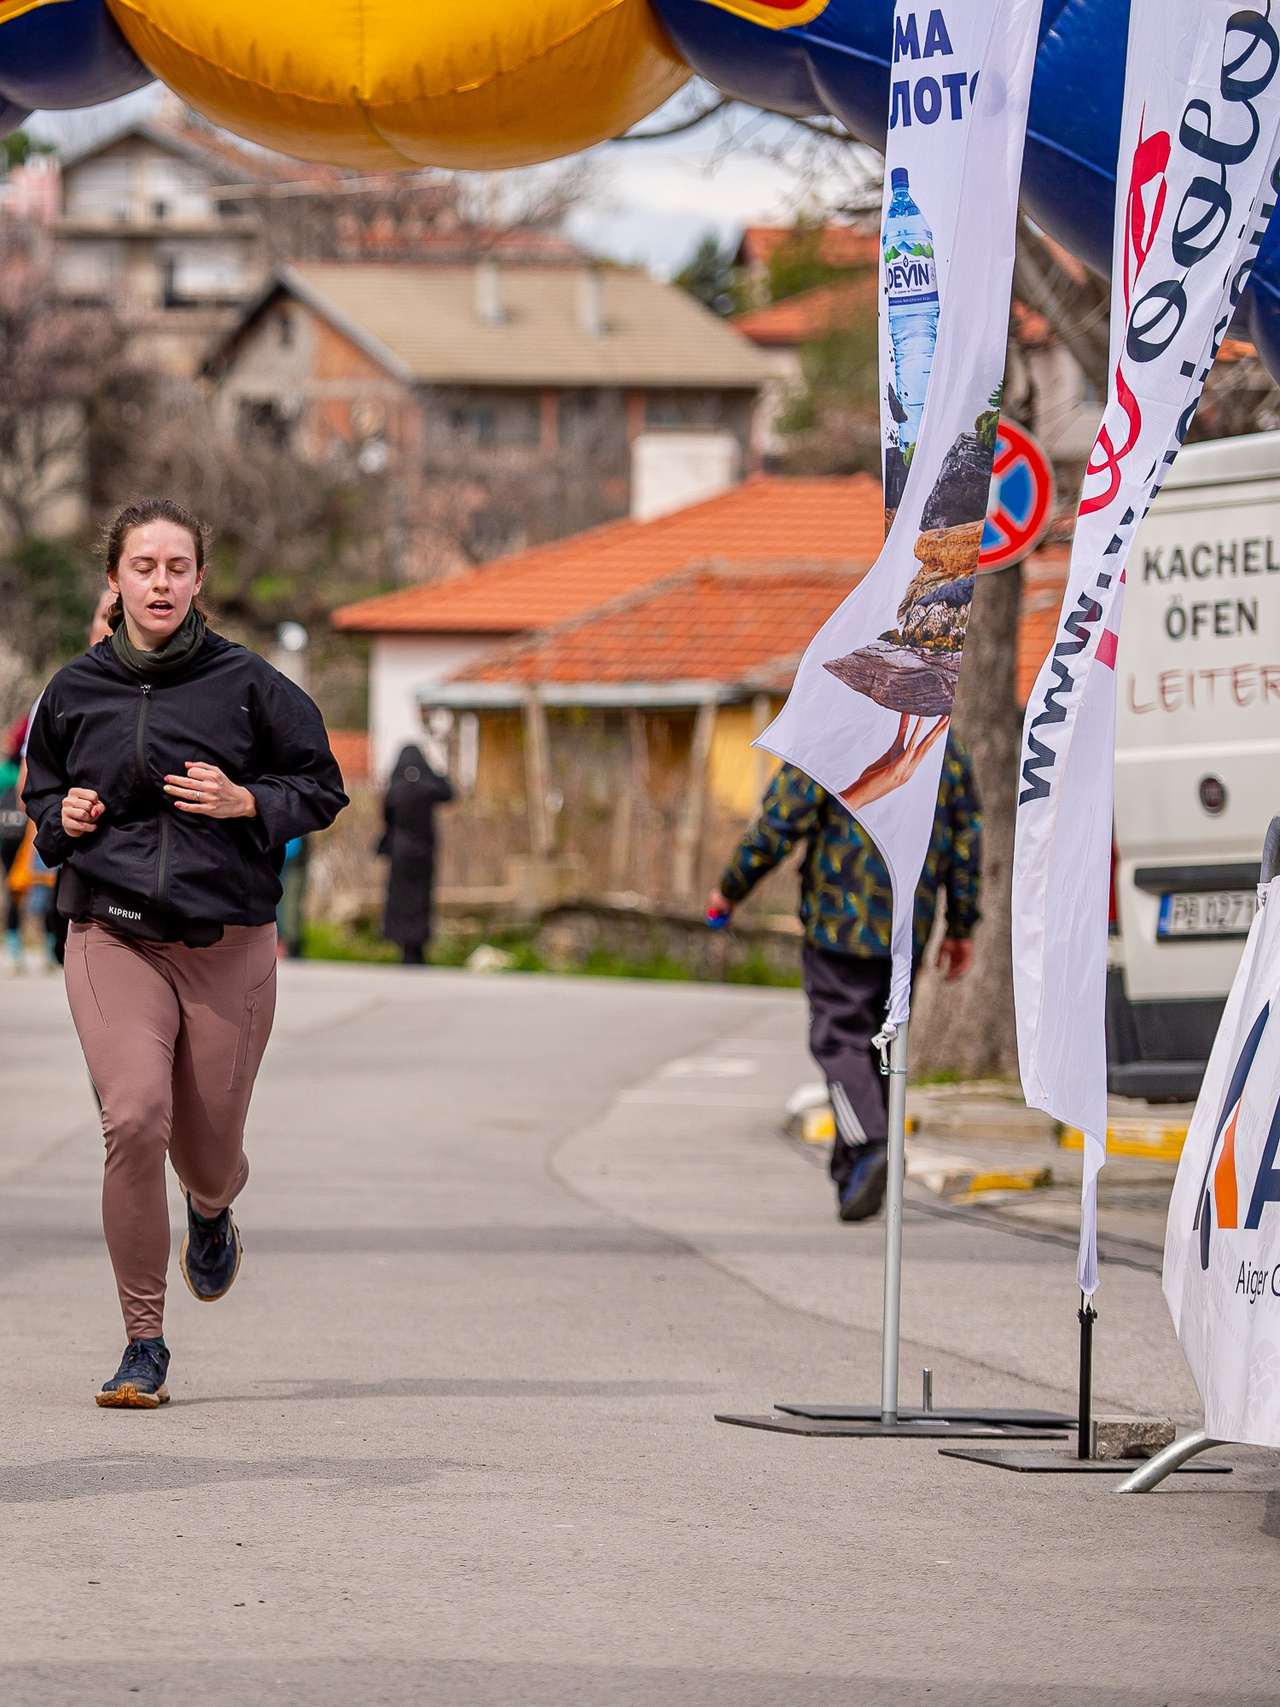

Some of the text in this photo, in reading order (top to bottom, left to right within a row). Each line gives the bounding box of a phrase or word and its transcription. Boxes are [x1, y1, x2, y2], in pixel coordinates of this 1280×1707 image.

[1165, 594, 1258, 640] ÖFEN
[108, 905, 142, 921] KIPRUN
[1235, 1260, 1269, 1305] Aiger
